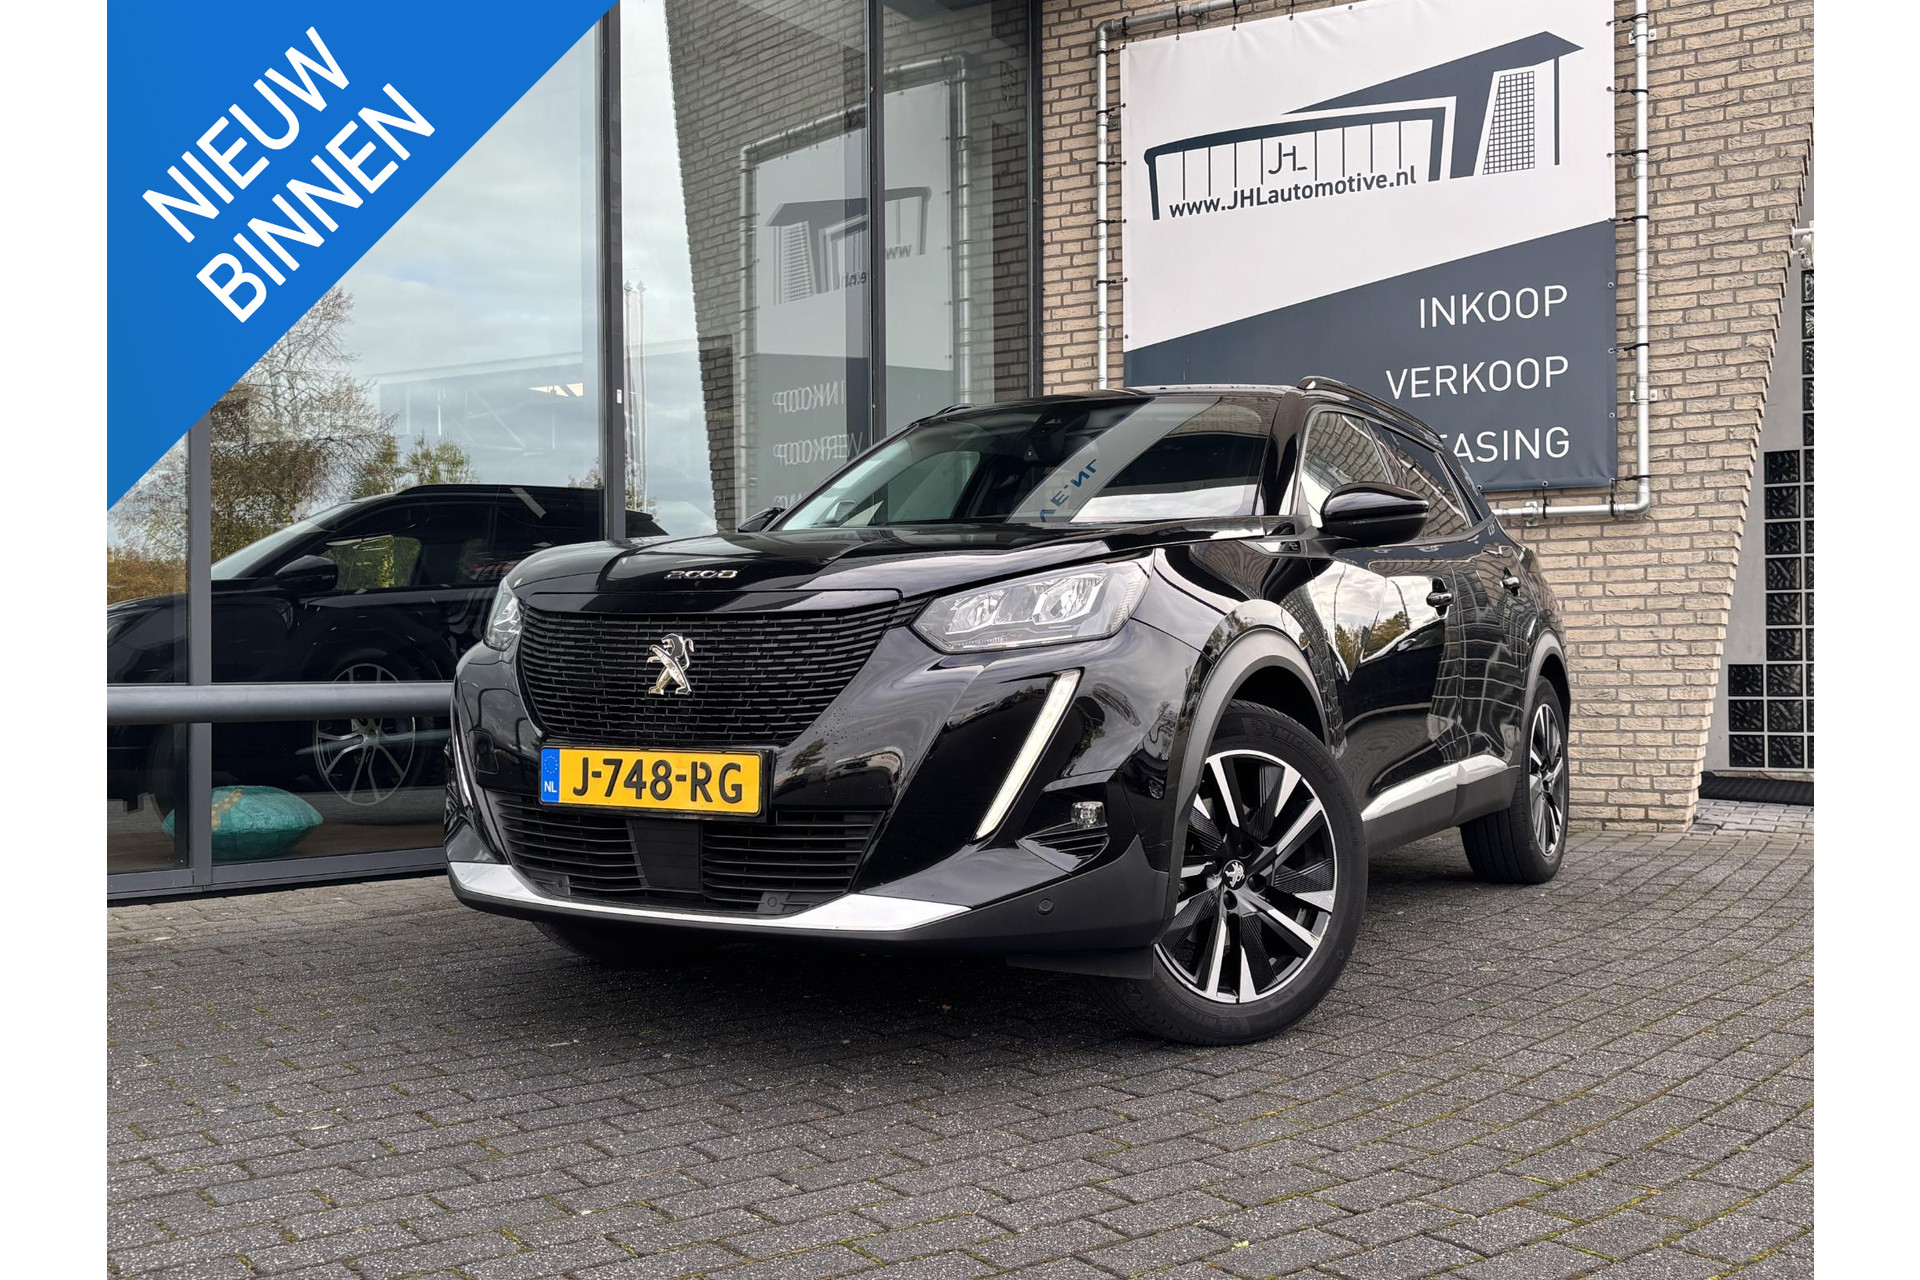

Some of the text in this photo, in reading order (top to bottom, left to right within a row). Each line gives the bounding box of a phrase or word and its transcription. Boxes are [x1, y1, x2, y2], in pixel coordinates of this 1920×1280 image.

[1169, 165, 1416, 218] www.JHLautomotive.nl
[1420, 284, 1567, 329] INKOOP
[1385, 355, 1569, 400] VERKOOP
[1440, 426, 1570, 463] ASING
[664, 569, 738, 580] 2008
[544, 780, 557, 793] NL
[572, 757, 742, 804] J-748-RG
